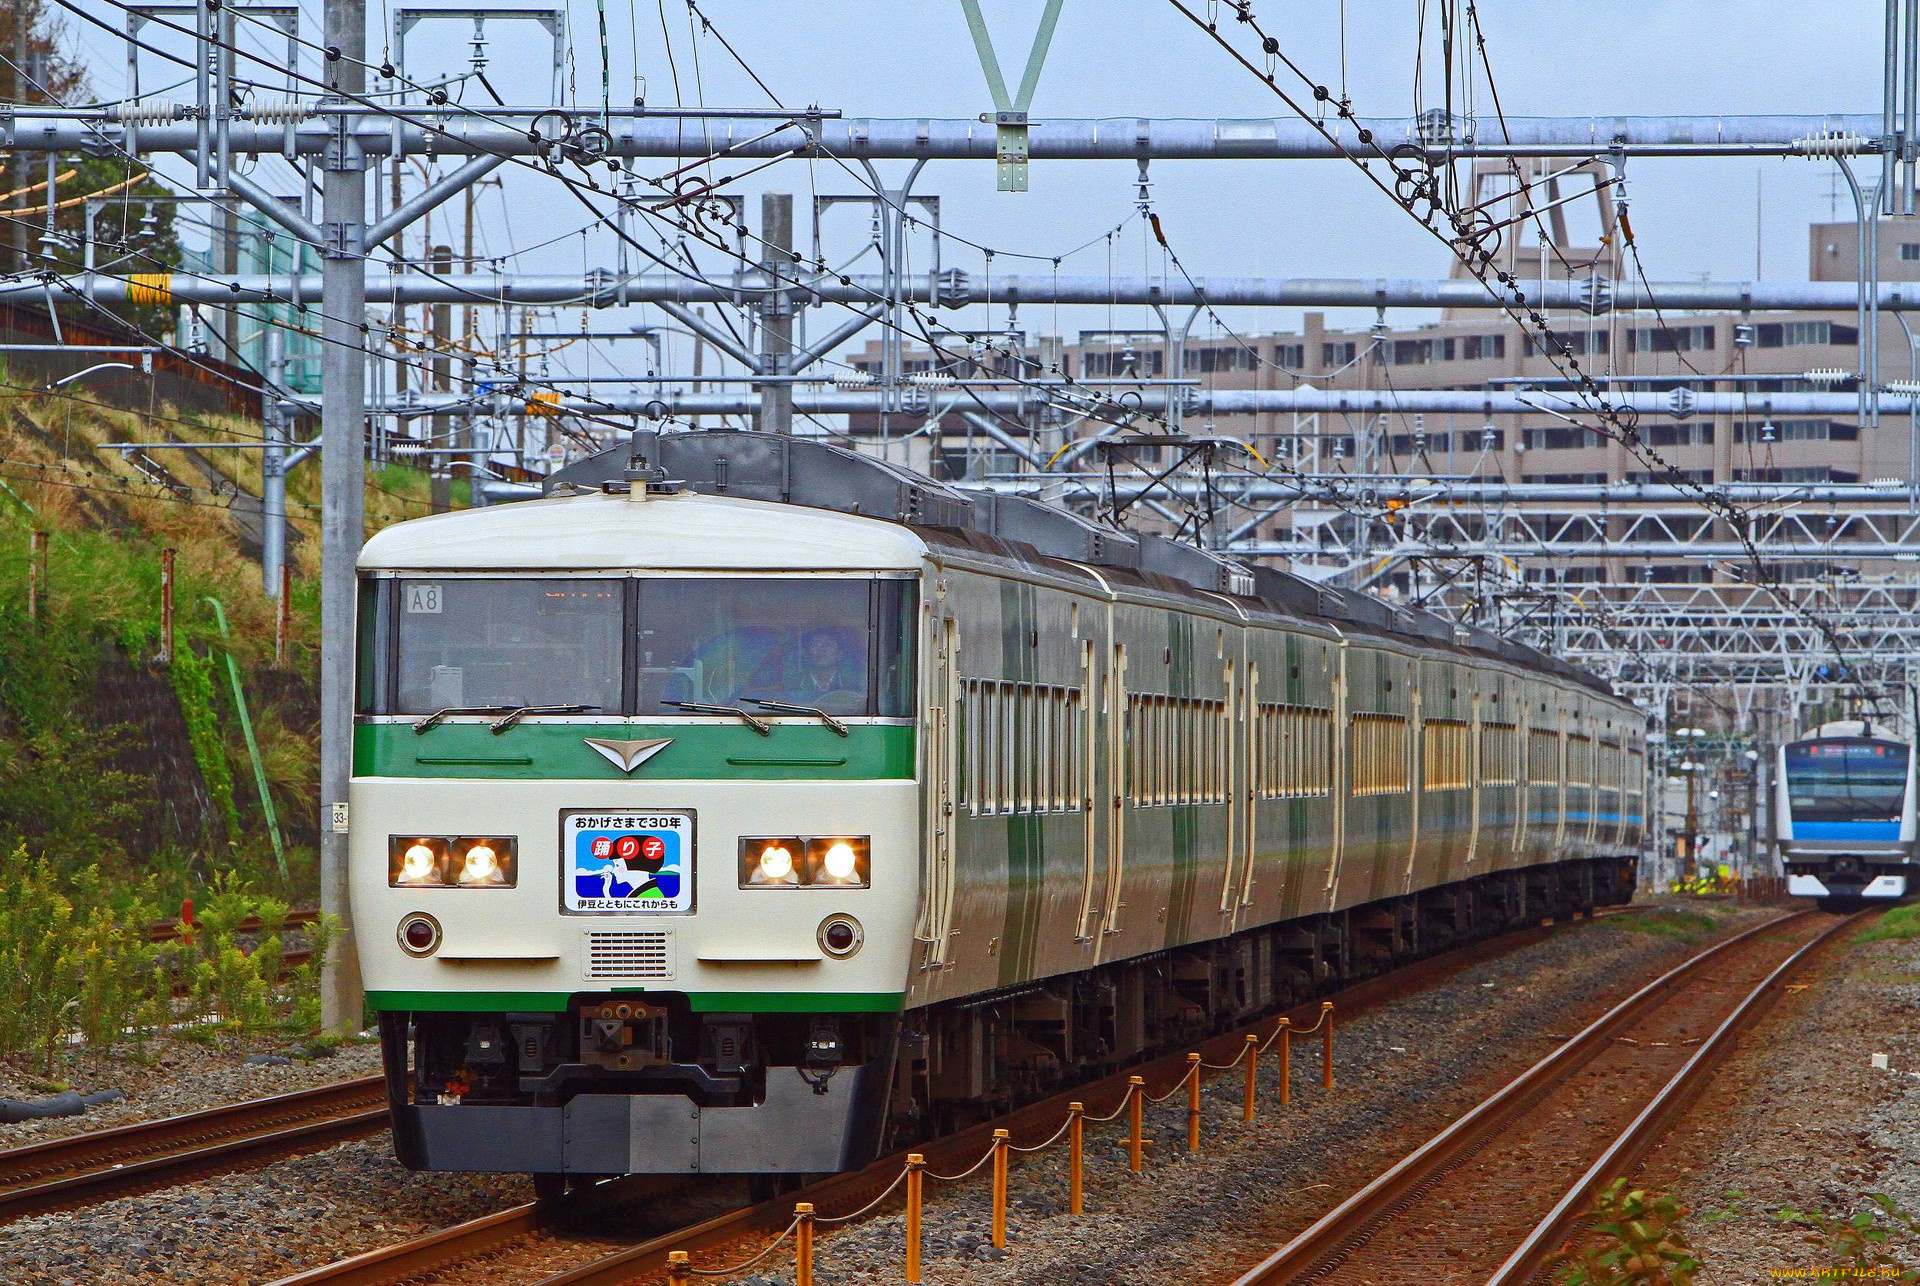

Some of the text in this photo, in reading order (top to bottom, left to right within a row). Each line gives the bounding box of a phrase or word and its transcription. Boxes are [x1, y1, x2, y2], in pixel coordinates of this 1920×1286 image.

[412, 590, 437, 610] A8
[575, 817, 681, 829] おかげさまで30年
[594, 840, 662, 856] 踊り子
[577, 900, 678, 909] 伊豆とともにこれからも
